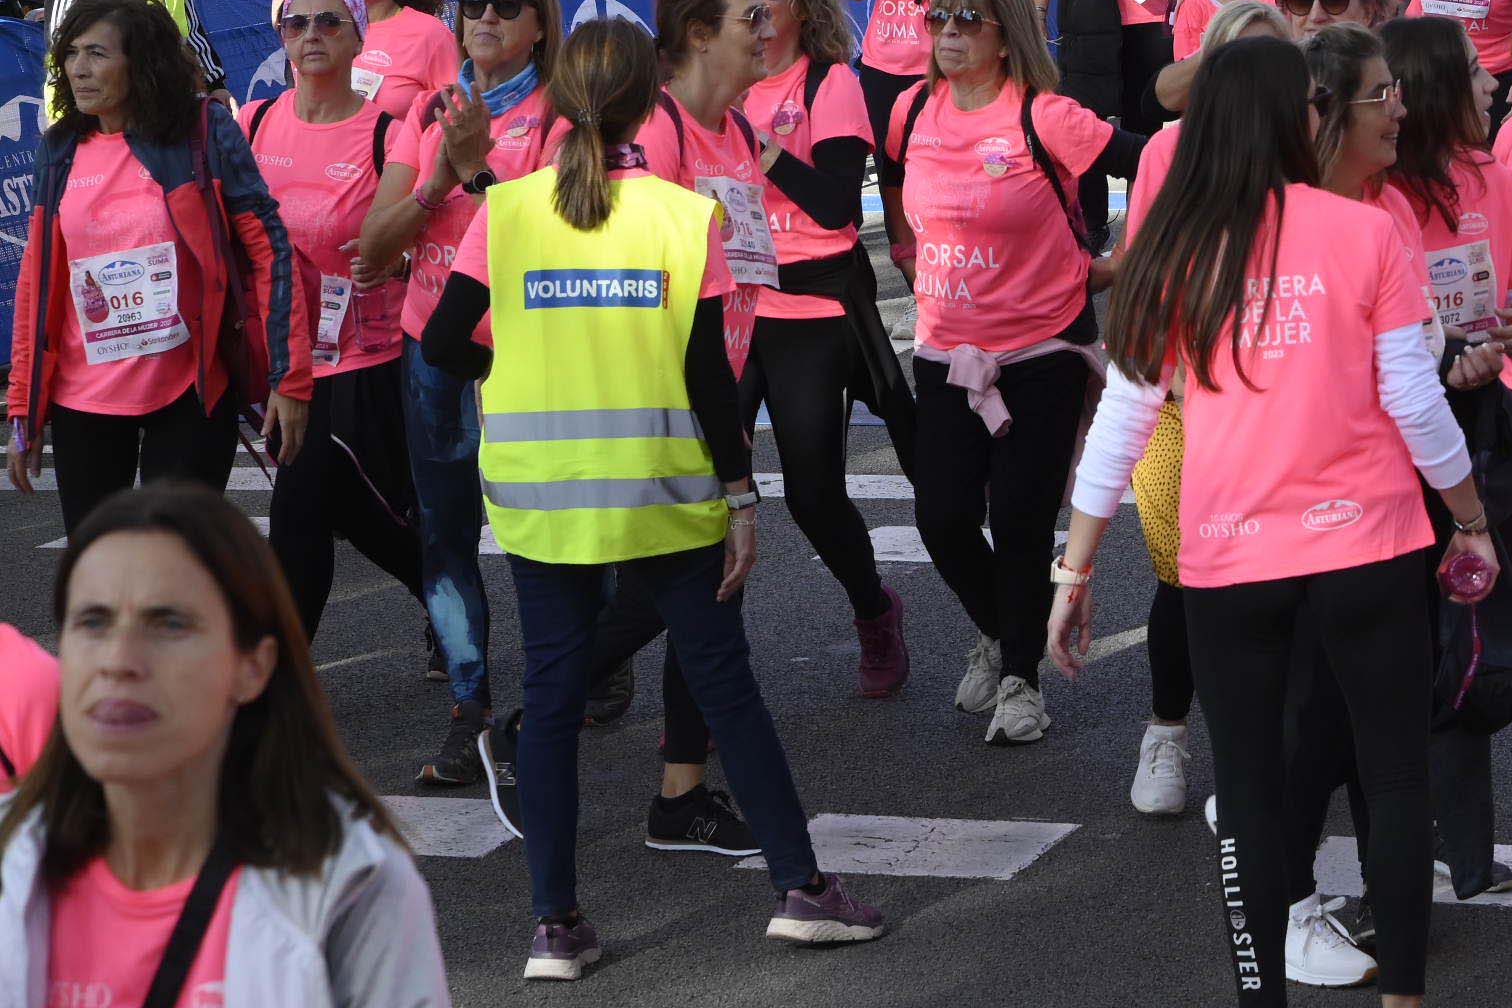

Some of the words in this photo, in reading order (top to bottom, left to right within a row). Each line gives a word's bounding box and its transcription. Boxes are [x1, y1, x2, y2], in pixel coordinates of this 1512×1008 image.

[255, 152, 294, 168] OYSHO
[101, 269, 142, 282] ASTURIANA
[147, 256, 170, 267] SUMA
[525, 278, 659, 300] VOLUNTARIS
[916, 269, 972, 301] SUMA
[110, 291, 144, 310] 016
[1275, 299, 1307, 322] LA
[95, 329, 121, 339] CARRERA
[97, 342, 129, 356] OYSHO
[1306, 510, 1358, 527] ASTURIANA
[1199, 519, 1261, 540] OYSHO
